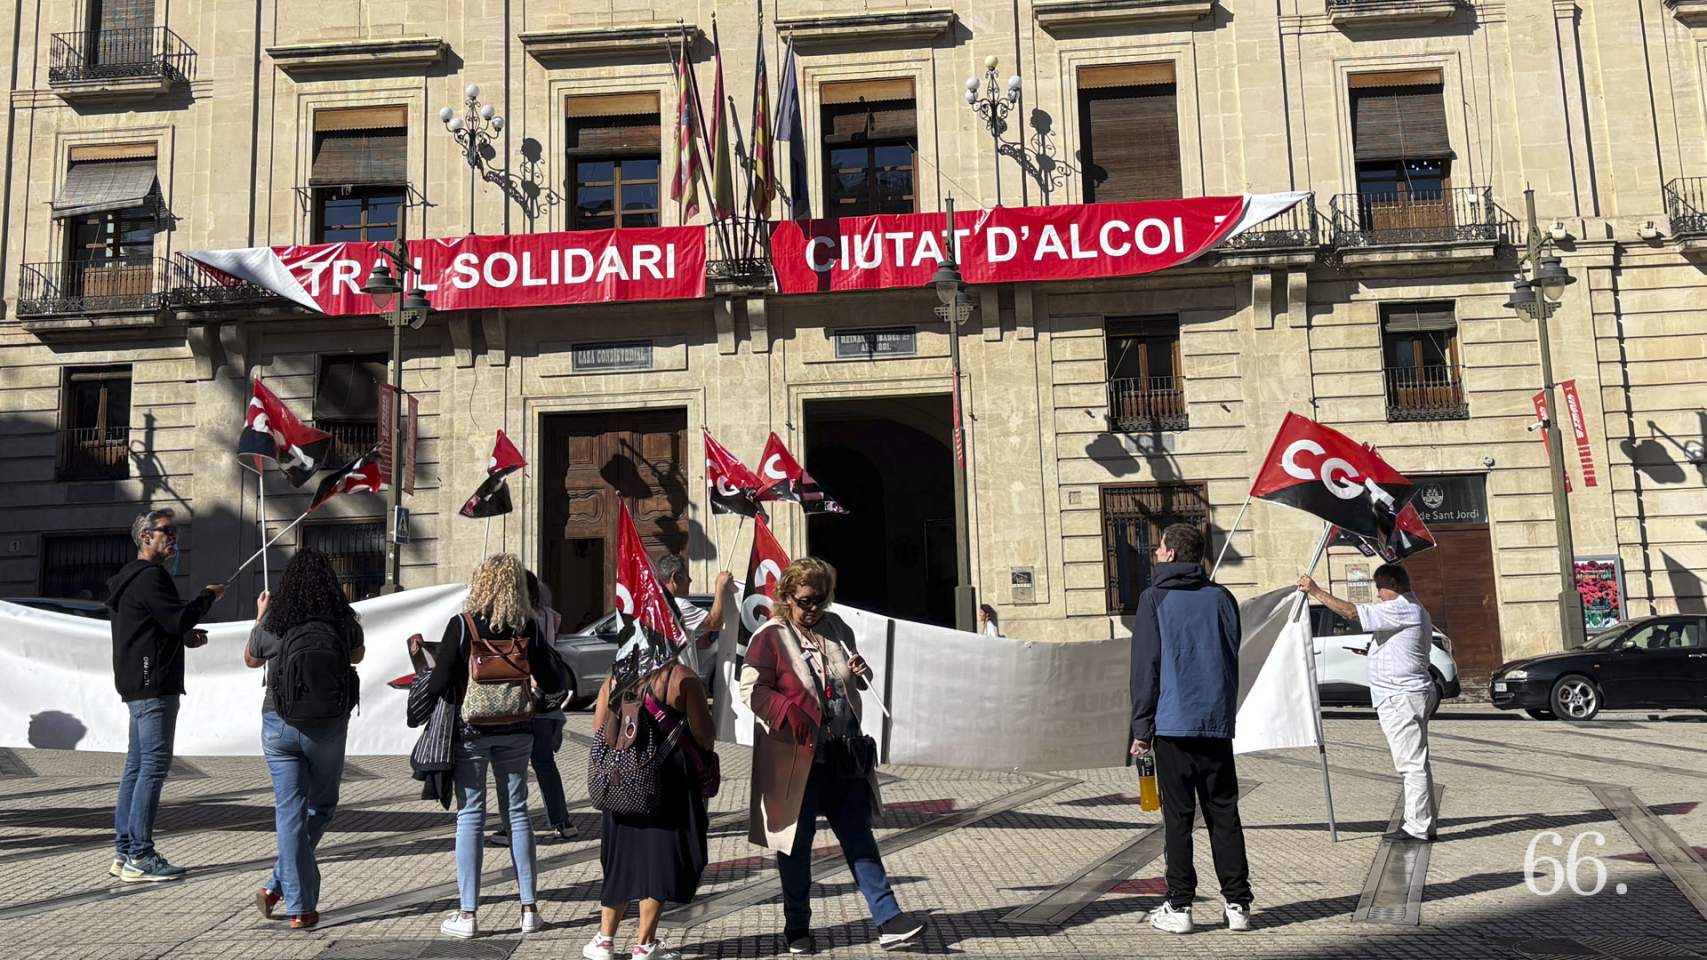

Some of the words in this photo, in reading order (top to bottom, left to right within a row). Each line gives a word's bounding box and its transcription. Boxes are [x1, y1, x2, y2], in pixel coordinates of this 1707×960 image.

[452, 243, 675, 289] SOLIDARI
[805, 228, 970, 273] CIUTAT
[986, 216, 1185, 263] D'ALCOI
[1433, 510, 1454, 520] Sant
[1456, 508, 1480, 520] Jordi
